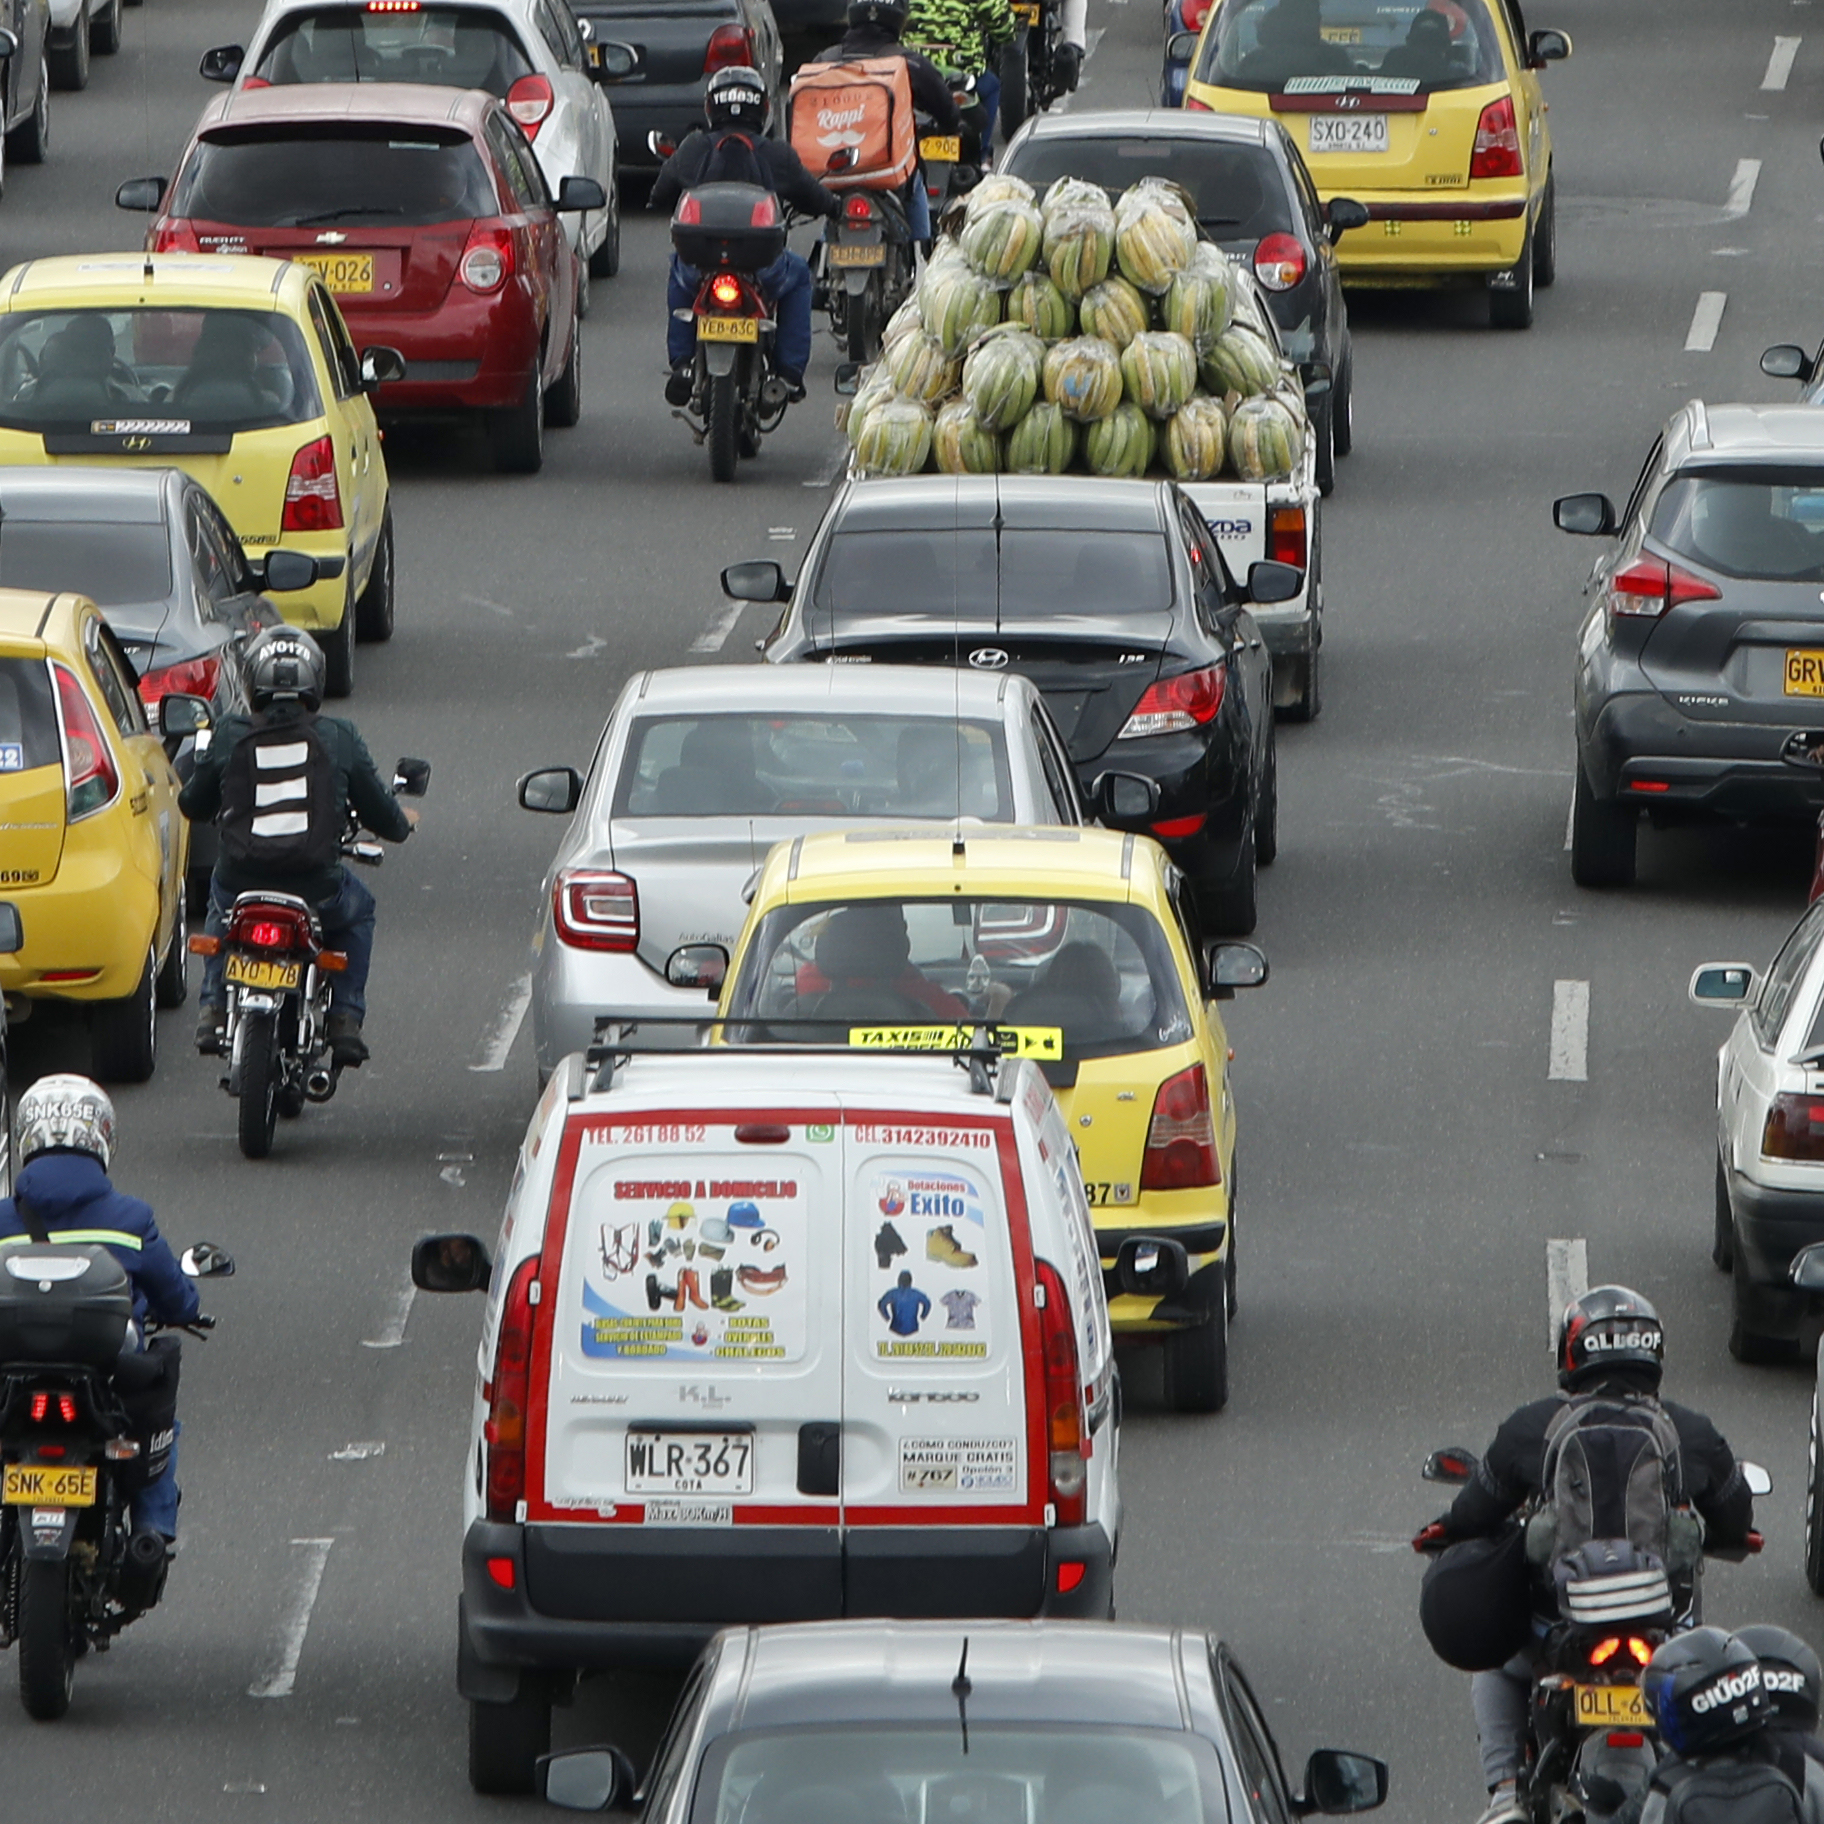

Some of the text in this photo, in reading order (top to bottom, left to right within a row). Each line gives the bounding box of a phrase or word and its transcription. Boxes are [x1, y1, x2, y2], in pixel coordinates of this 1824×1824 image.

[816, 103, 865, 129] Rappi
[26, 1102, 94, 1124] SNK65E
[587, 1125, 706, 1145] TEL. 261 88 52
[613, 1180, 797, 1200] SERVICIO A DOMICILIO
[907, 1180, 966, 1193] Dotaciones
[903, 1438, 1015, 1450] ¿COMO CONDUZCO?
[903, 1452, 1014, 1464] MARQUE GRATIS
[674, 1479, 703, 1491] COTA
